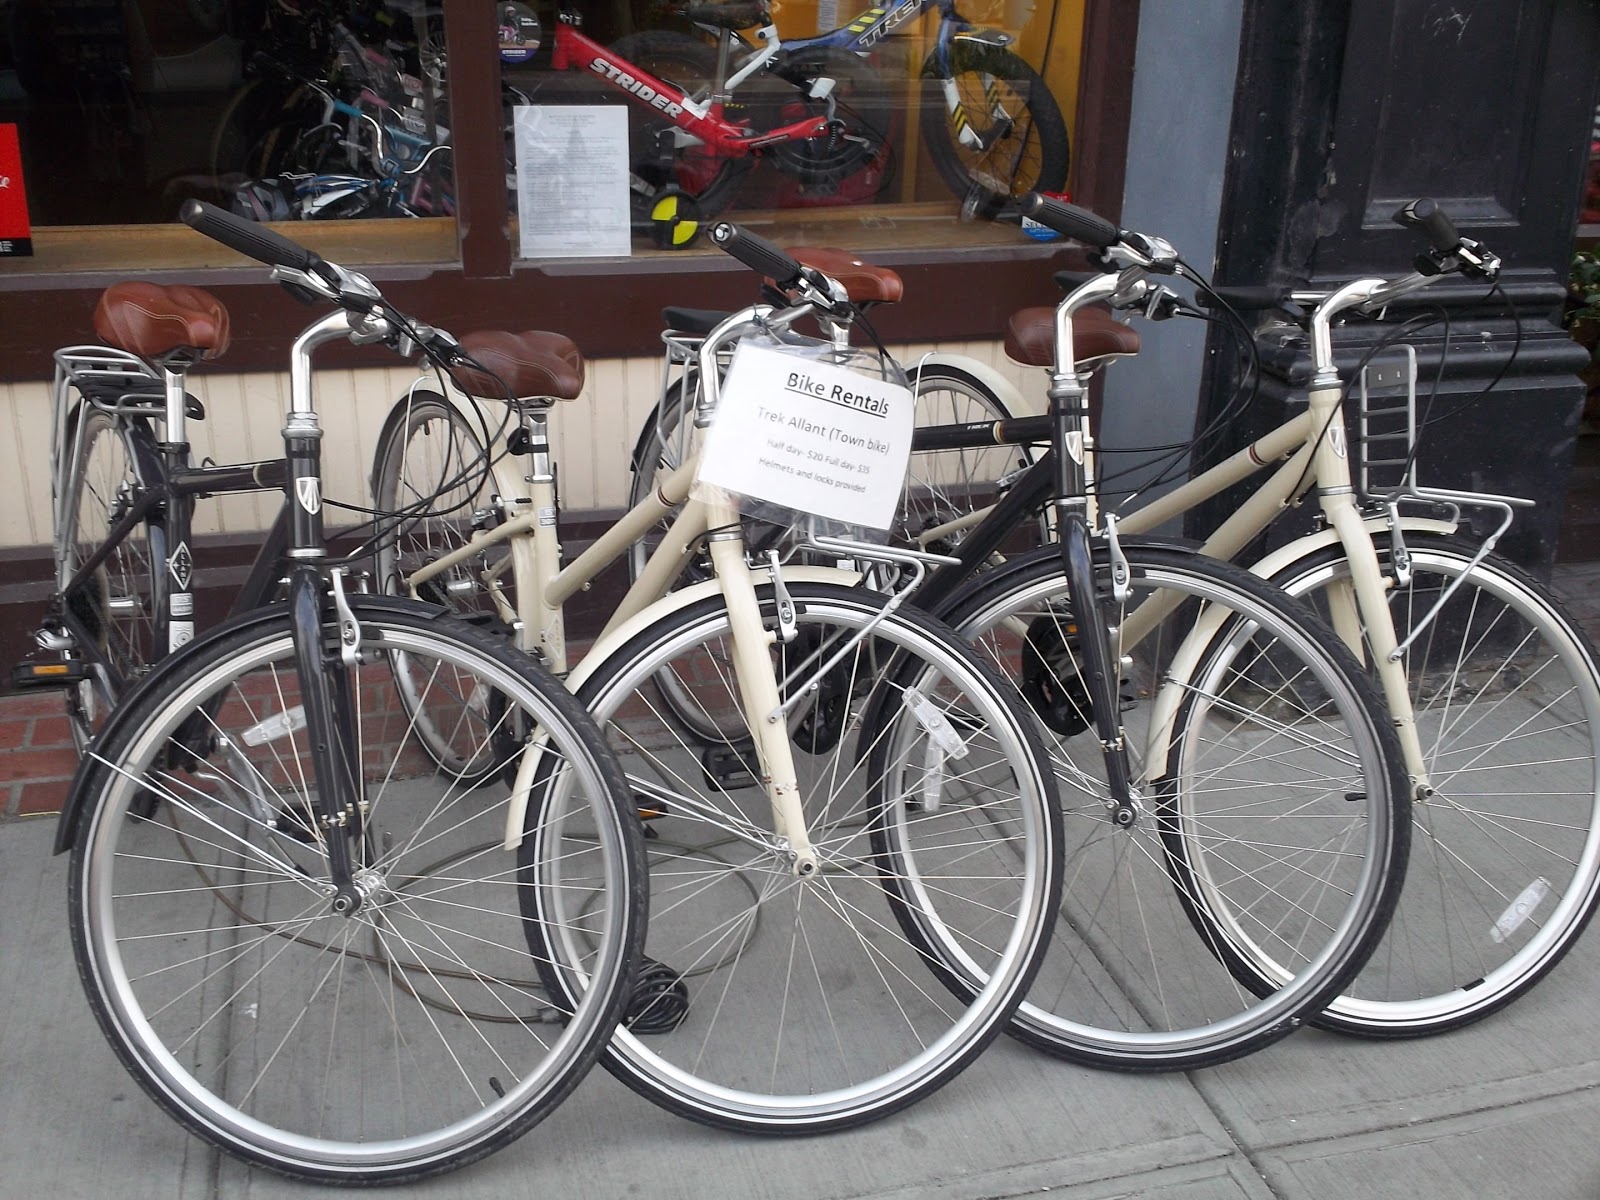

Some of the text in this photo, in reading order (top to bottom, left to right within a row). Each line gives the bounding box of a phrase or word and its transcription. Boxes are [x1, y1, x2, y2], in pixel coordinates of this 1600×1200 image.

[589, 57, 684, 119] STRIDER
[787, 372, 890, 415] Bike Rentals
[758, 406, 890, 456] Trek Allant (Town bike)
[758, 457, 867, 493] Helmets and locks provided
[767, 439, 785, 450] Half
[807, 450, 824, 462] $20
[825, 455, 840, 466] Full
[857, 464, 871, 474] $35
